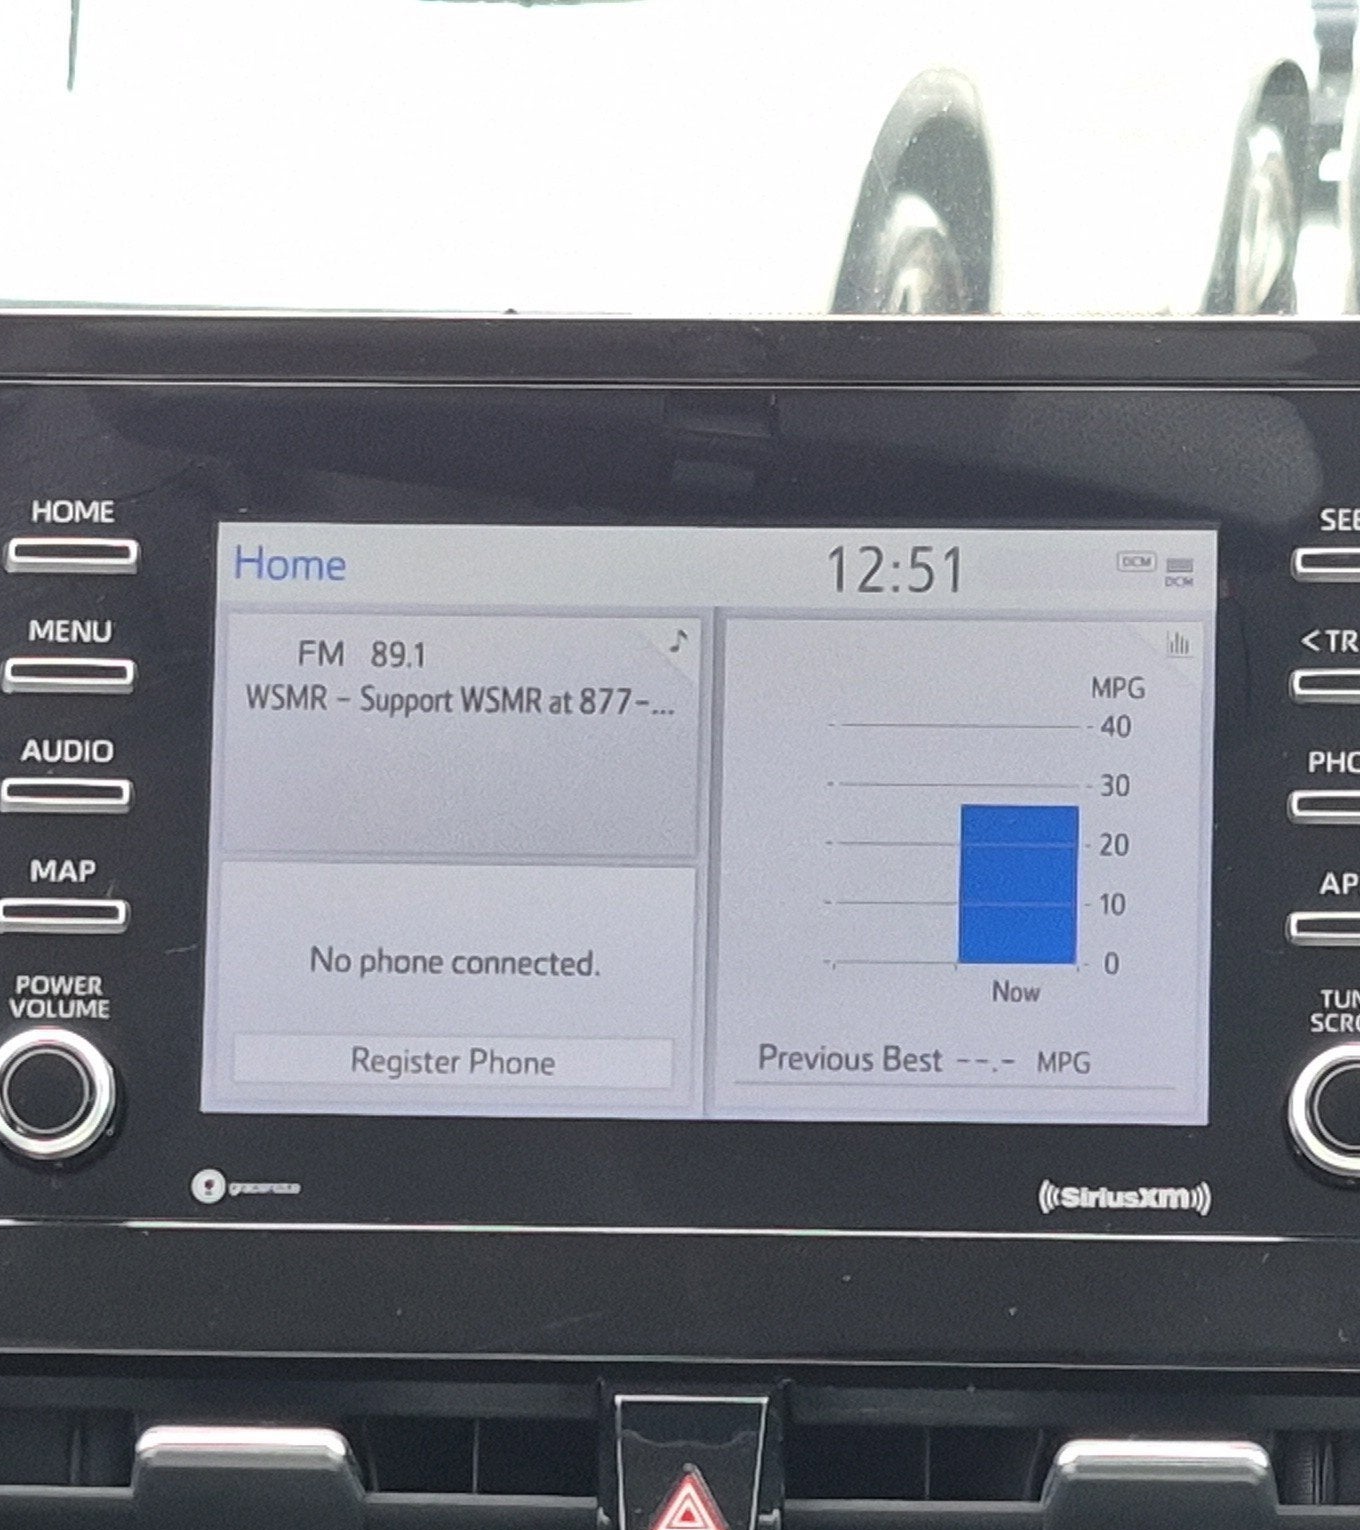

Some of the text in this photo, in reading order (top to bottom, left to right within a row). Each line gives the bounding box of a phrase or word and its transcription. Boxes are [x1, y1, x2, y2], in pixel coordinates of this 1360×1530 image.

[32, 500, 115, 523] HOME
[234, 545, 347, 582] Home
[828, 545, 963, 594] 12:51
[28, 619, 113, 643] MENU
[299, 640, 425, 668] FM 89.1
[1092, 676, 1146, 700] MPG
[246, 684, 327, 711] WSMR
[360, 685, 454, 718] Support
[461, 687, 542, 714] WSMR
[549, 689, 572, 715] at
[1100, 716, 1131, 738] 40
[20, 739, 115, 763] AUDIO
[1099, 774, 1131, 797] 30
[1099, 833, 1130, 856] 20
[30, 860, 96, 882] MAP
[1100, 893, 1127, 916] 10
[311, 945, 600, 978] No phone connected.
[1104, 953, 1119, 975] 0
[16, 975, 103, 996] POWER
[992, 981, 1041, 1003] Now
[10, 998, 111, 1019] VOLUME
[351, 1046, 556, 1080] Register Phone
[759, 1043, 874, 1072] Previous
[883, 1046, 943, 1073] Best
[1037, 1052, 1091, 1074] MPG
